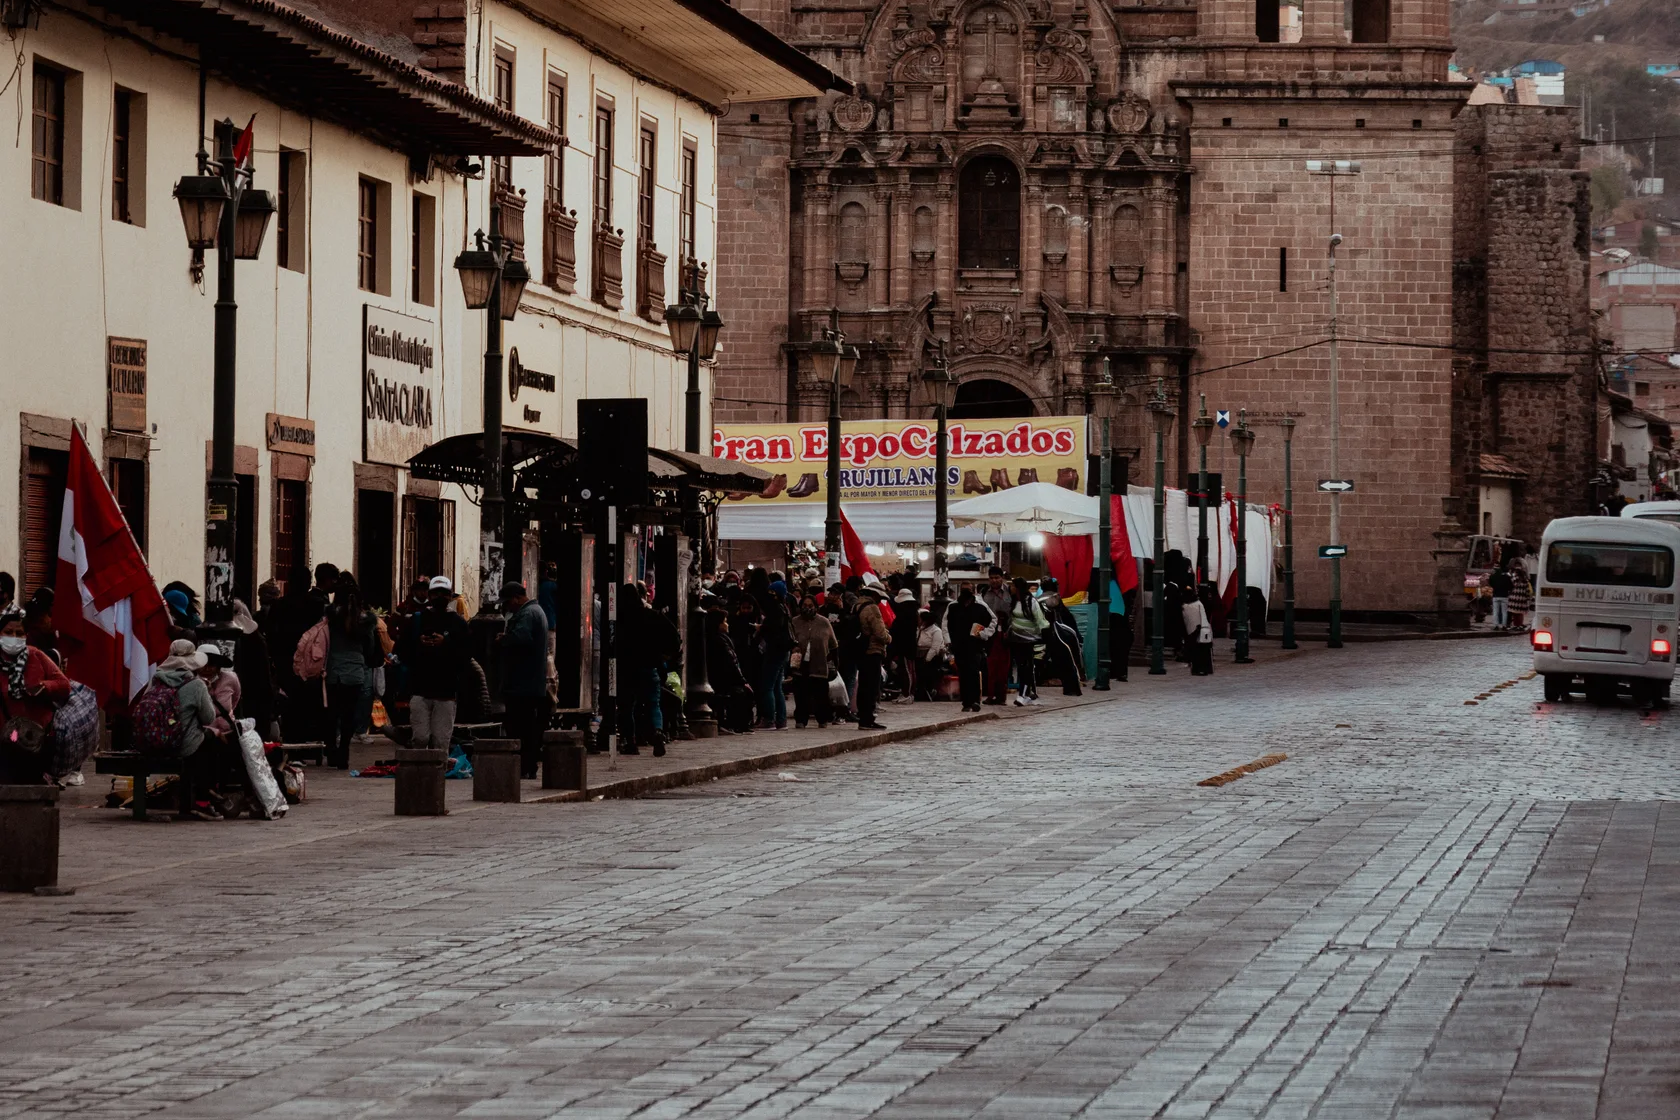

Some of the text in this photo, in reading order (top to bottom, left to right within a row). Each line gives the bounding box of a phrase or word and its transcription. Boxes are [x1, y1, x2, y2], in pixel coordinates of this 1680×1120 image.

[367, 368, 433, 429] SANTA CLARA
[825, 466, 960, 488] RUJILLANS
